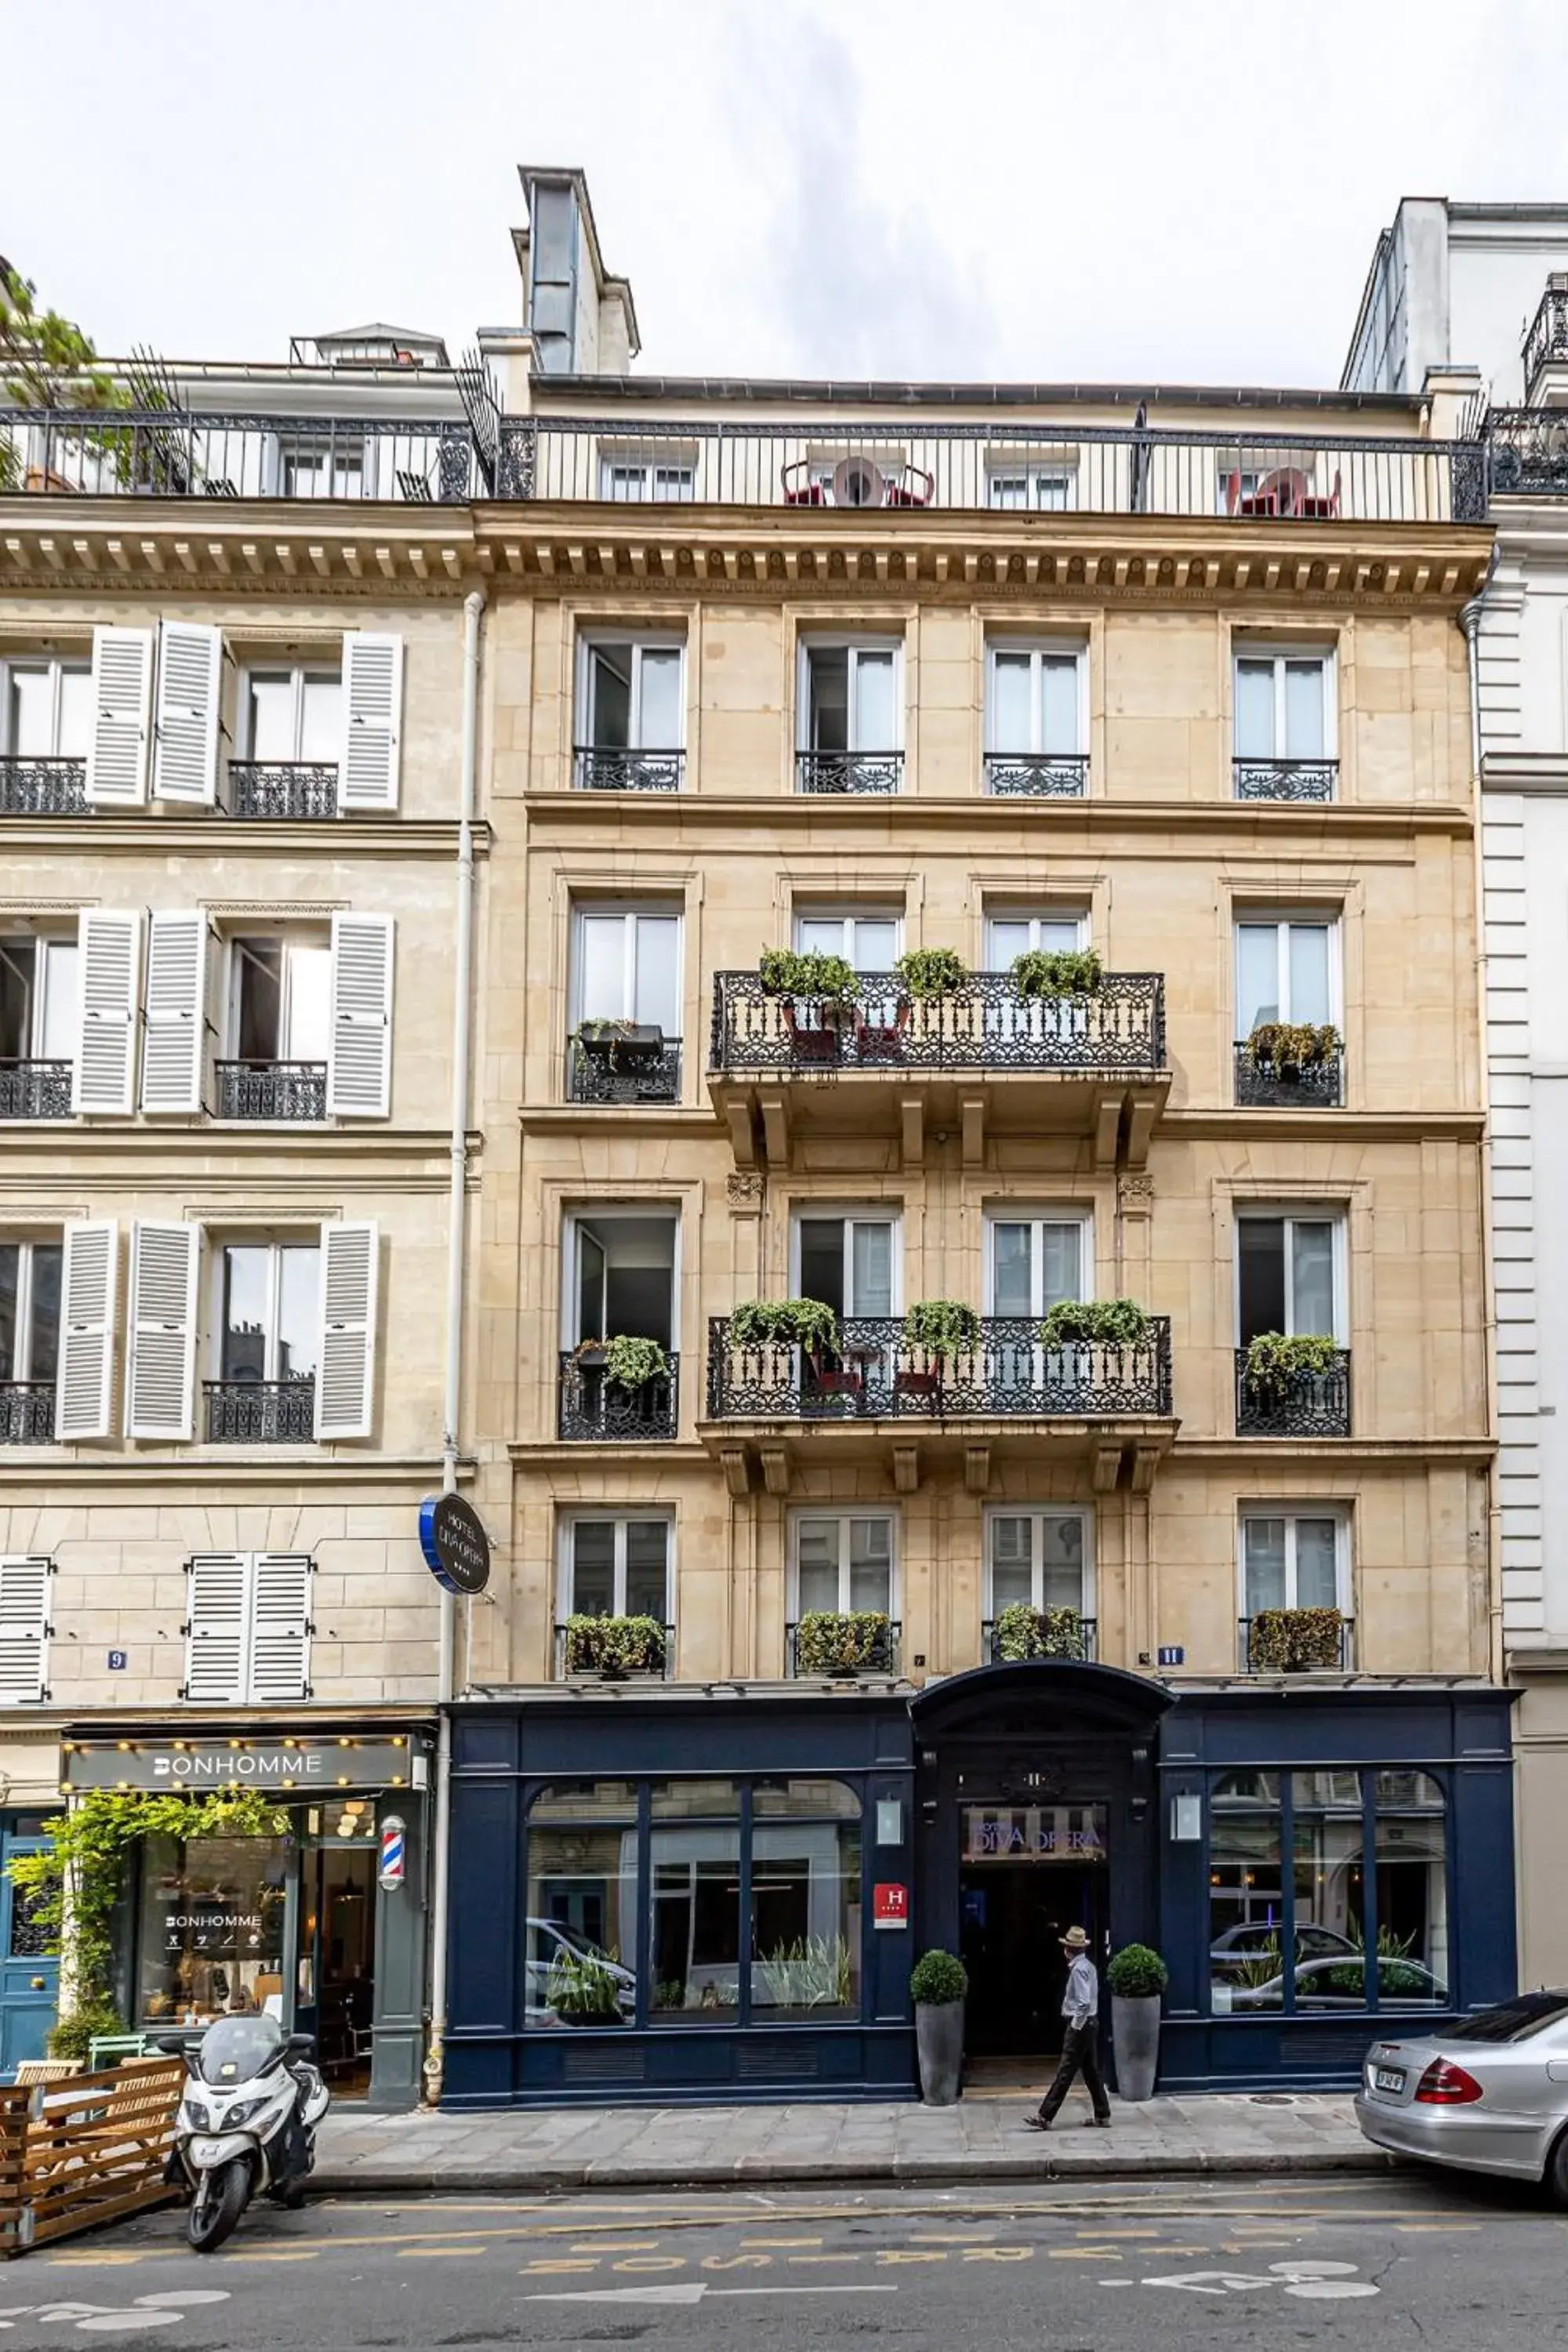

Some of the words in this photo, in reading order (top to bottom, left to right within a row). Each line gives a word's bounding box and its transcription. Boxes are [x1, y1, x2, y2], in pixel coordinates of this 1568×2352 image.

[448, 1511, 477, 1543] HOTEL
[112, 1653, 122, 1668] 9
[1165, 1649, 1176, 1663] 11
[154, 1755, 321, 1775] BONHOMME
[974, 1827, 1025, 1850] DIVA
[888, 1890, 903, 1904] H
[165, 1915, 263, 1927] BONHOMME
